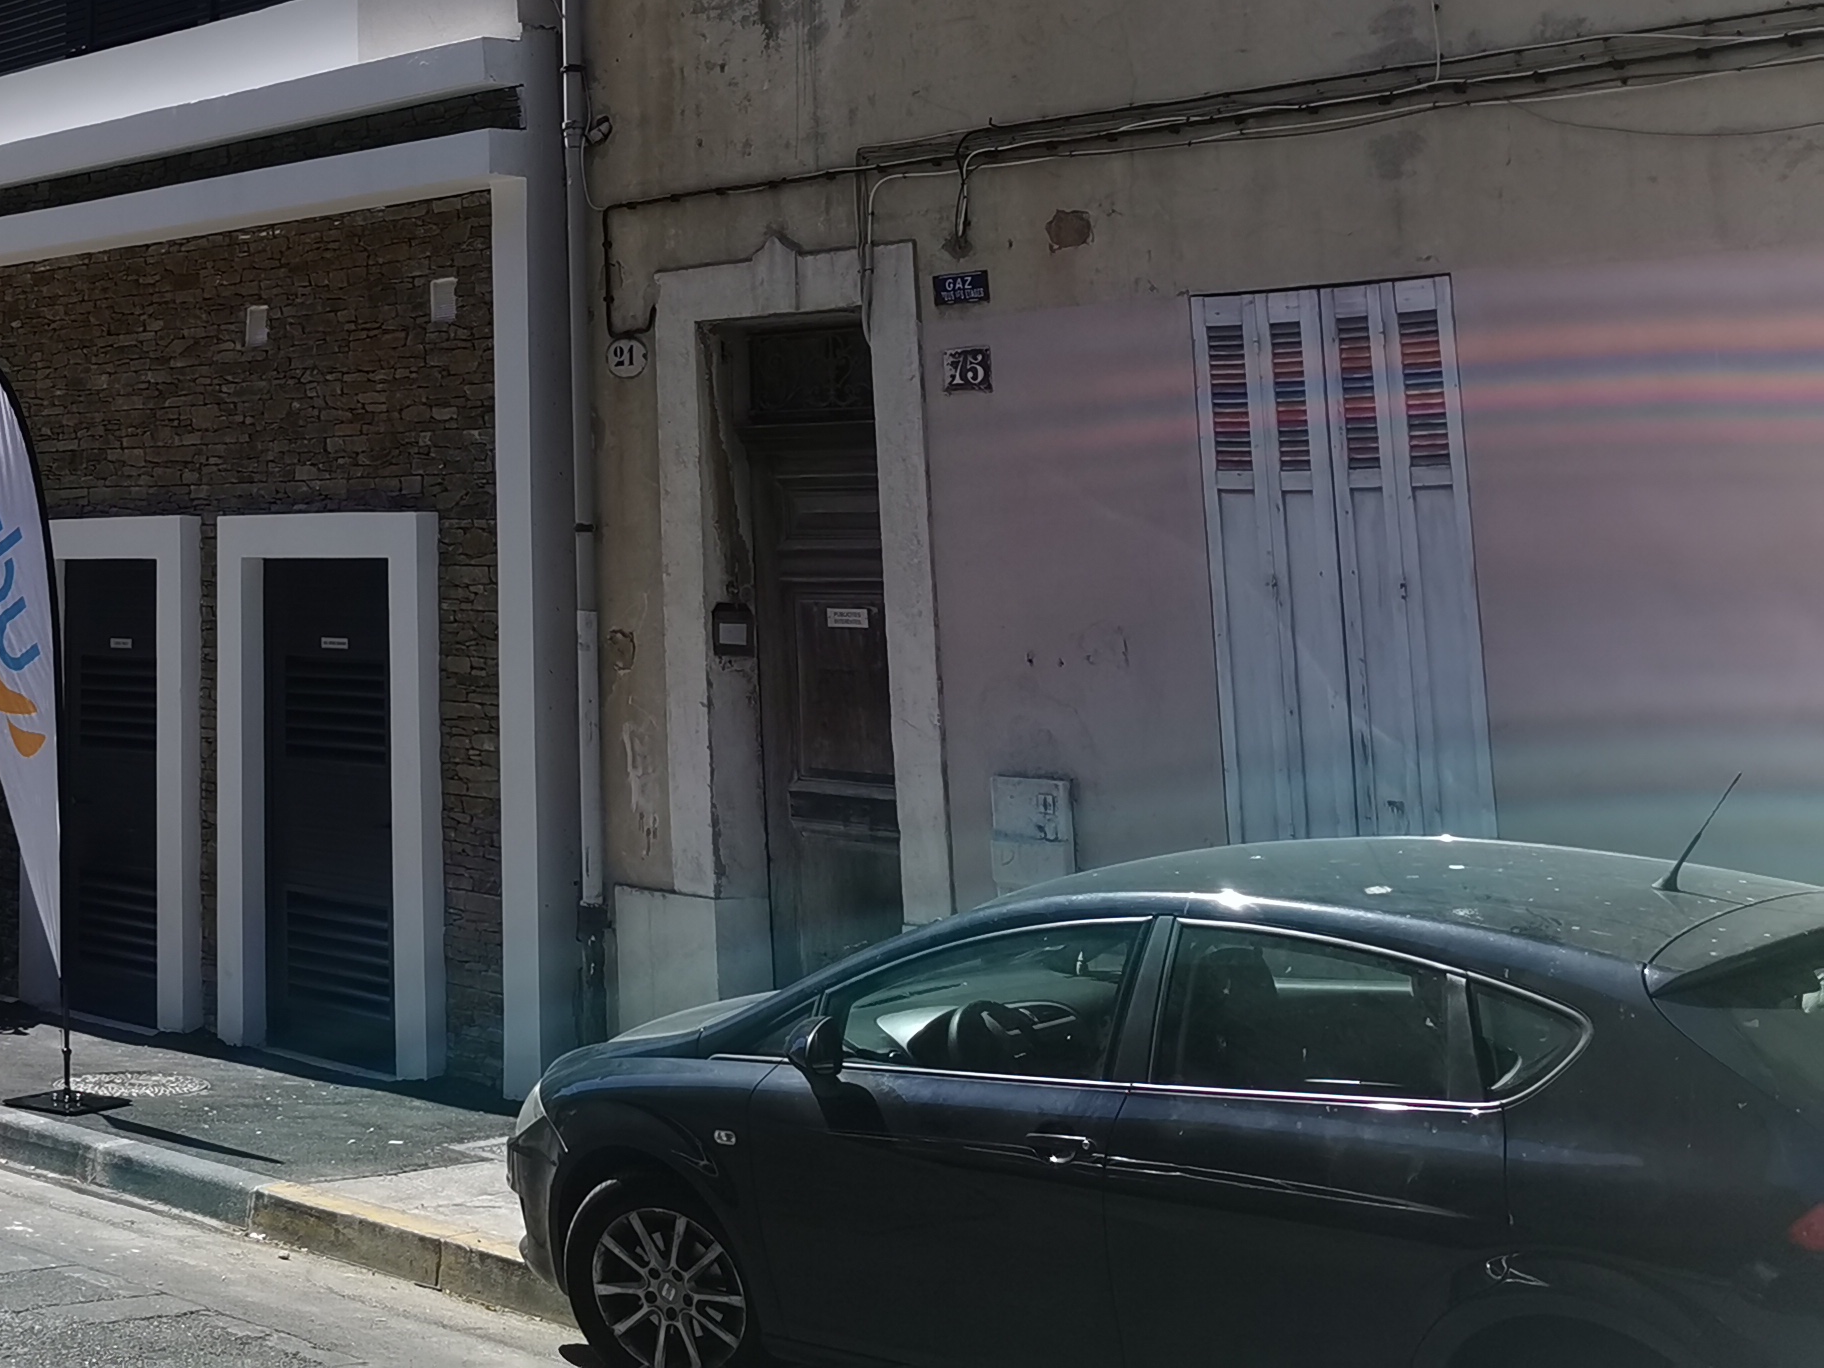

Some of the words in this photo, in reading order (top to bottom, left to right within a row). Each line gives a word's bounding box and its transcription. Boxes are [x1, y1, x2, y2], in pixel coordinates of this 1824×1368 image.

[945, 277, 972, 290] GAZ
[613, 344, 635, 368] 21
[950, 352, 985, 384] 75
